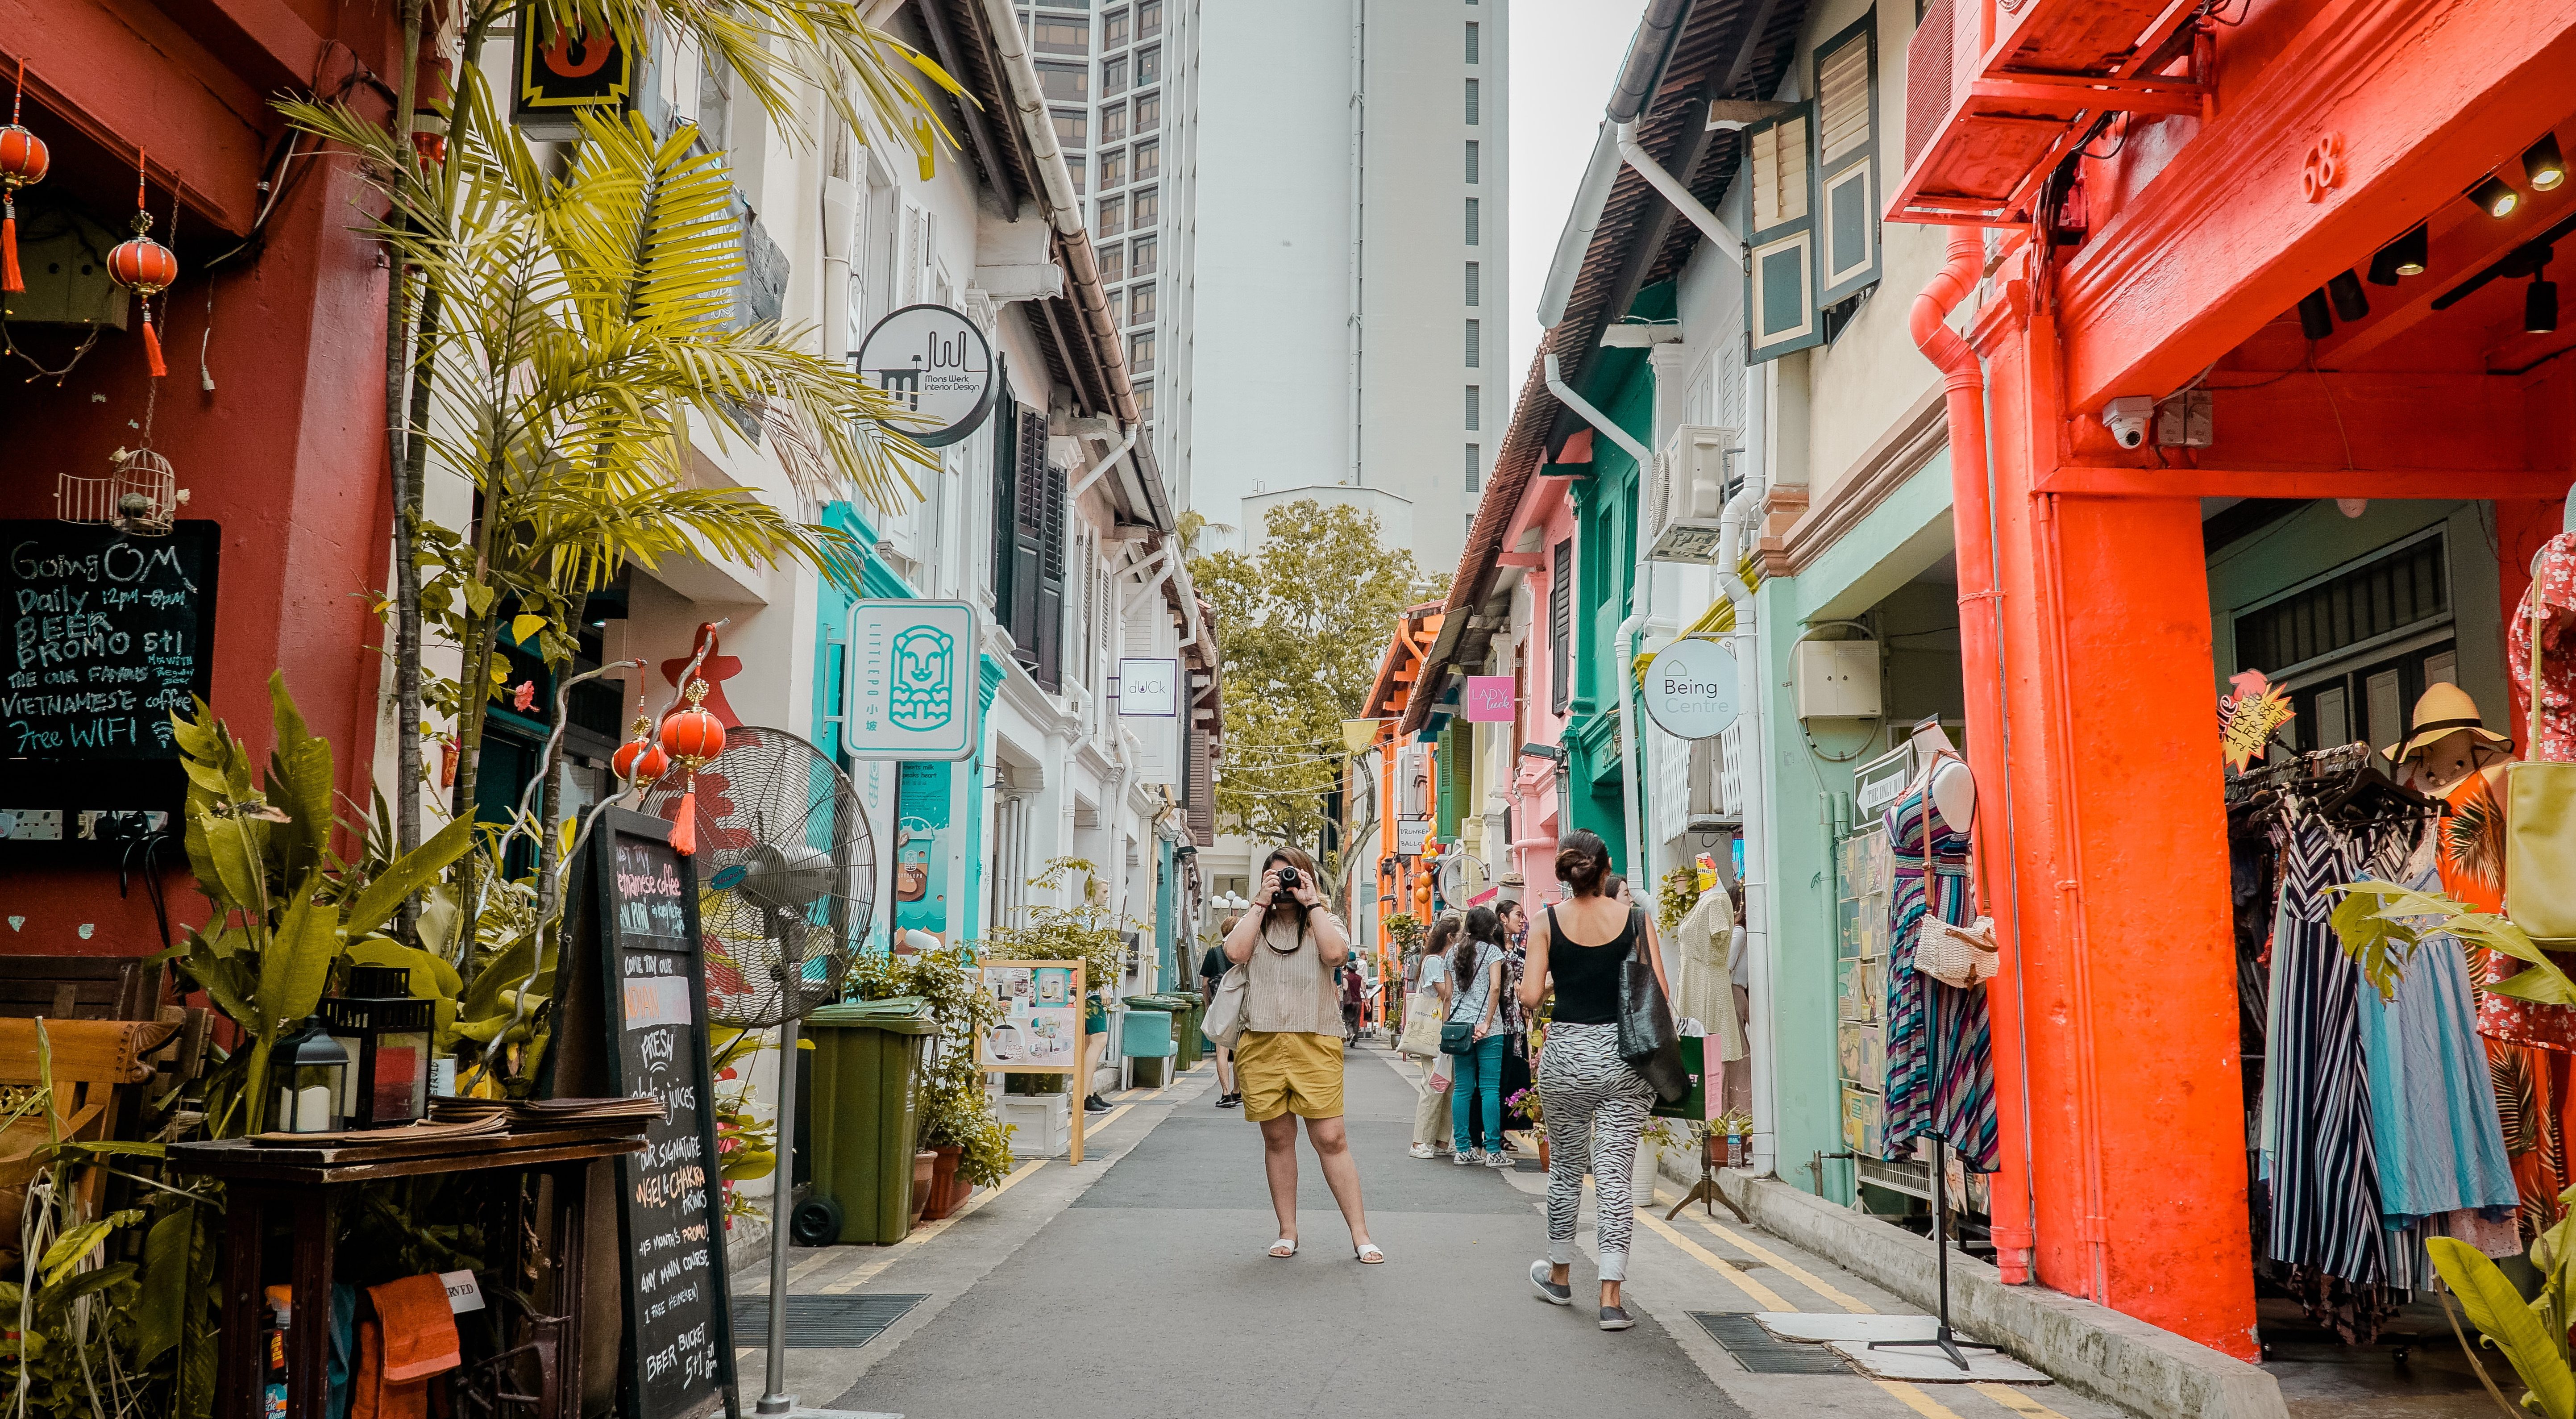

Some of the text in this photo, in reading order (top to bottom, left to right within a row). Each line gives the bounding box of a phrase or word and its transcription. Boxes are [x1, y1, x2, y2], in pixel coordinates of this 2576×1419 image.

[2300, 132, 2334, 202] 68
[954, 383, 980, 393] Design
[11, 541, 98, 581] Going
[16, 584, 89, 615] Daily
[14, 612, 113, 649] BEER
[17, 632, 131, 670] PROMO
[867, 624, 881, 696] LITTLEPO
[8, 671, 37, 688] THE
[1665, 679, 1717, 698] Being
[1, 689, 191, 717] VIETNAMESE coffee
[1472, 689, 1507, 700] LADY
[1487, 695, 1512, 711] luck
[1666, 698, 1729, 713] Centre
[866, 704, 878, 732] 小坡
[2231, 711, 2251, 733] FOR
[2235, 701, 2276, 752] 2 FOR $36
[8, 717, 136, 753] Free WIFI
[2225, 734, 2238, 745] 1
[2248, 740, 2261, 753] NO
[1867, 776, 1902, 804] THE ONLY WAY
[617, 866, 656, 901] etnamese
[657, 863, 681, 897] coffee
[625, 955, 673, 976] COME TRY OUR
[665, 1077, 695, 1122] juices
[641, 1144, 657, 1171] OUR
[659, 1136, 701, 1168] SIGNATURE
[636, 1165, 705, 1208] NGEL & CHAKRA
[683, 1189, 707, 1215] DRINKS
[653, 1227, 681, 1251] MONTH'S
[641, 1249, 710, 1293] ANY MAIN COURSE
[446, 1284, 474, 1298] RVED
[651, 1301, 665, 1318] FREE
[647, 1322, 705, 1382] BEER BUCKET
